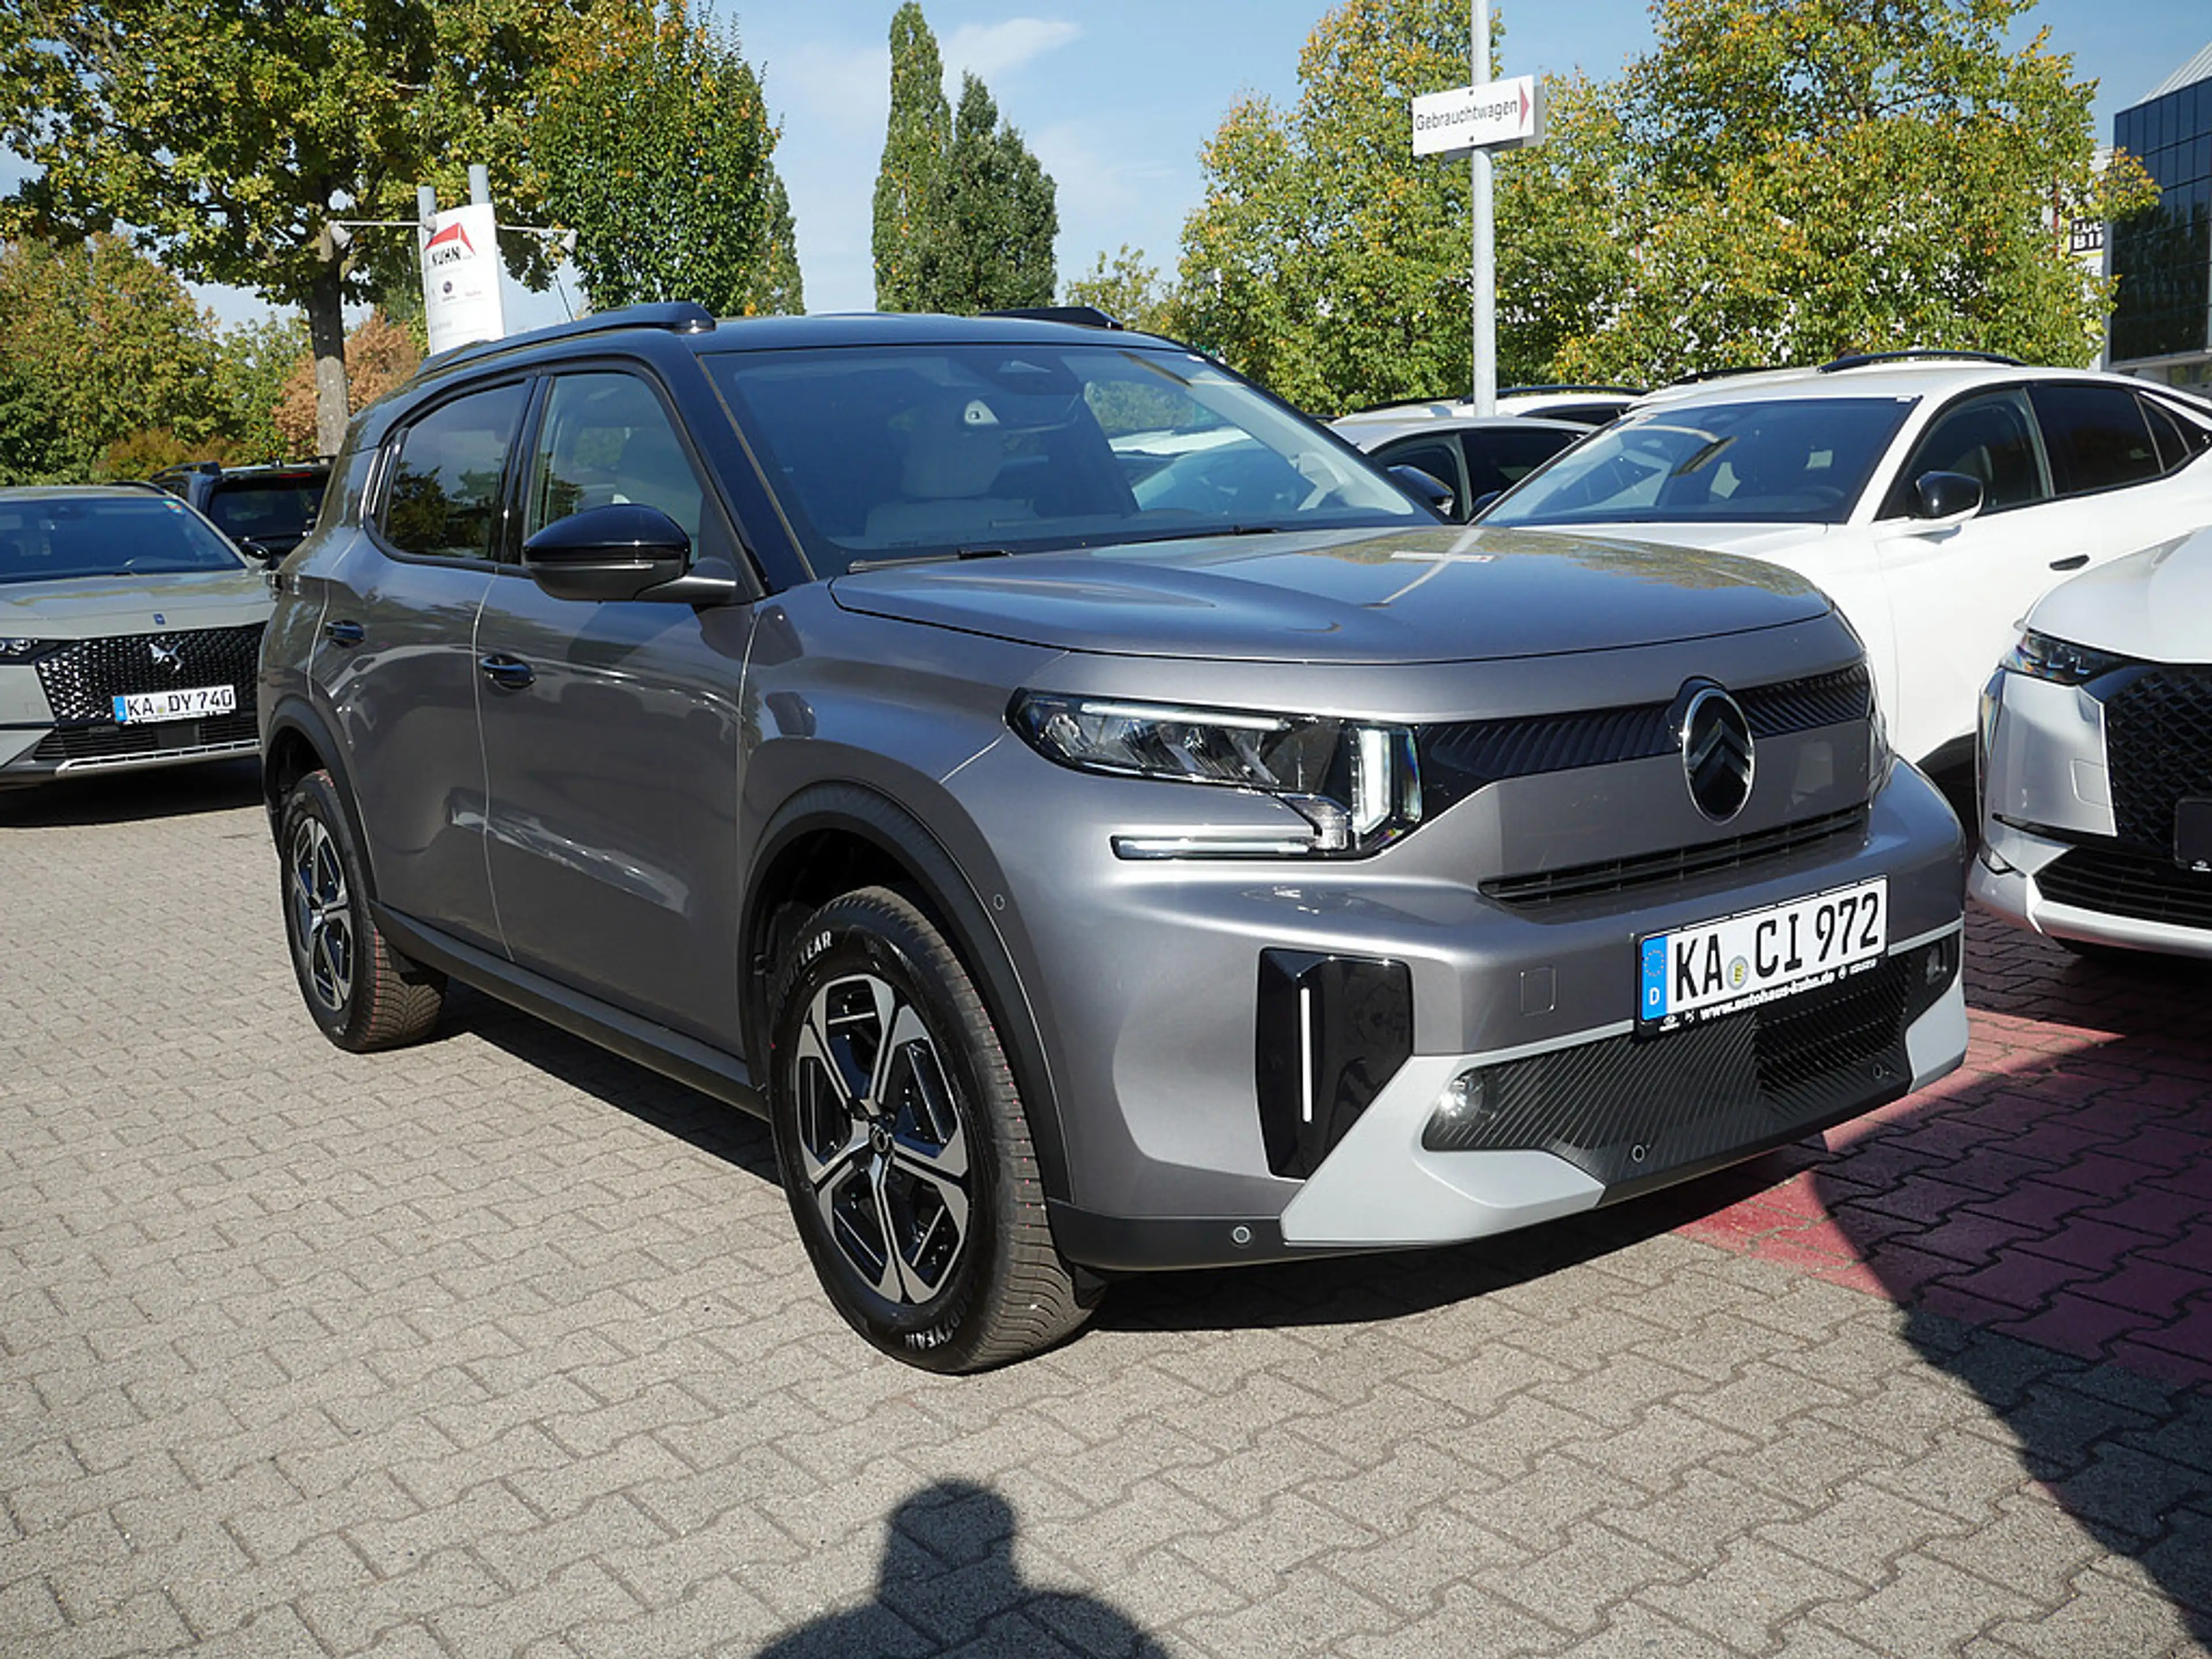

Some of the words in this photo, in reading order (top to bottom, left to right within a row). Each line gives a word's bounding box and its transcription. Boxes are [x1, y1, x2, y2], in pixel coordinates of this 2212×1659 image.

[1415, 100, 1517, 130] Gebrauchtwagen
[127, 698, 154, 715] KA
[168, 694, 191, 712] DY
[197, 689, 232, 709] 740
[1676, 934, 1723, 1002] KA
[1755, 913, 1803, 979] CI
[1816, 892, 1878, 963] 972
[1649, 987, 1660, 1006] D
